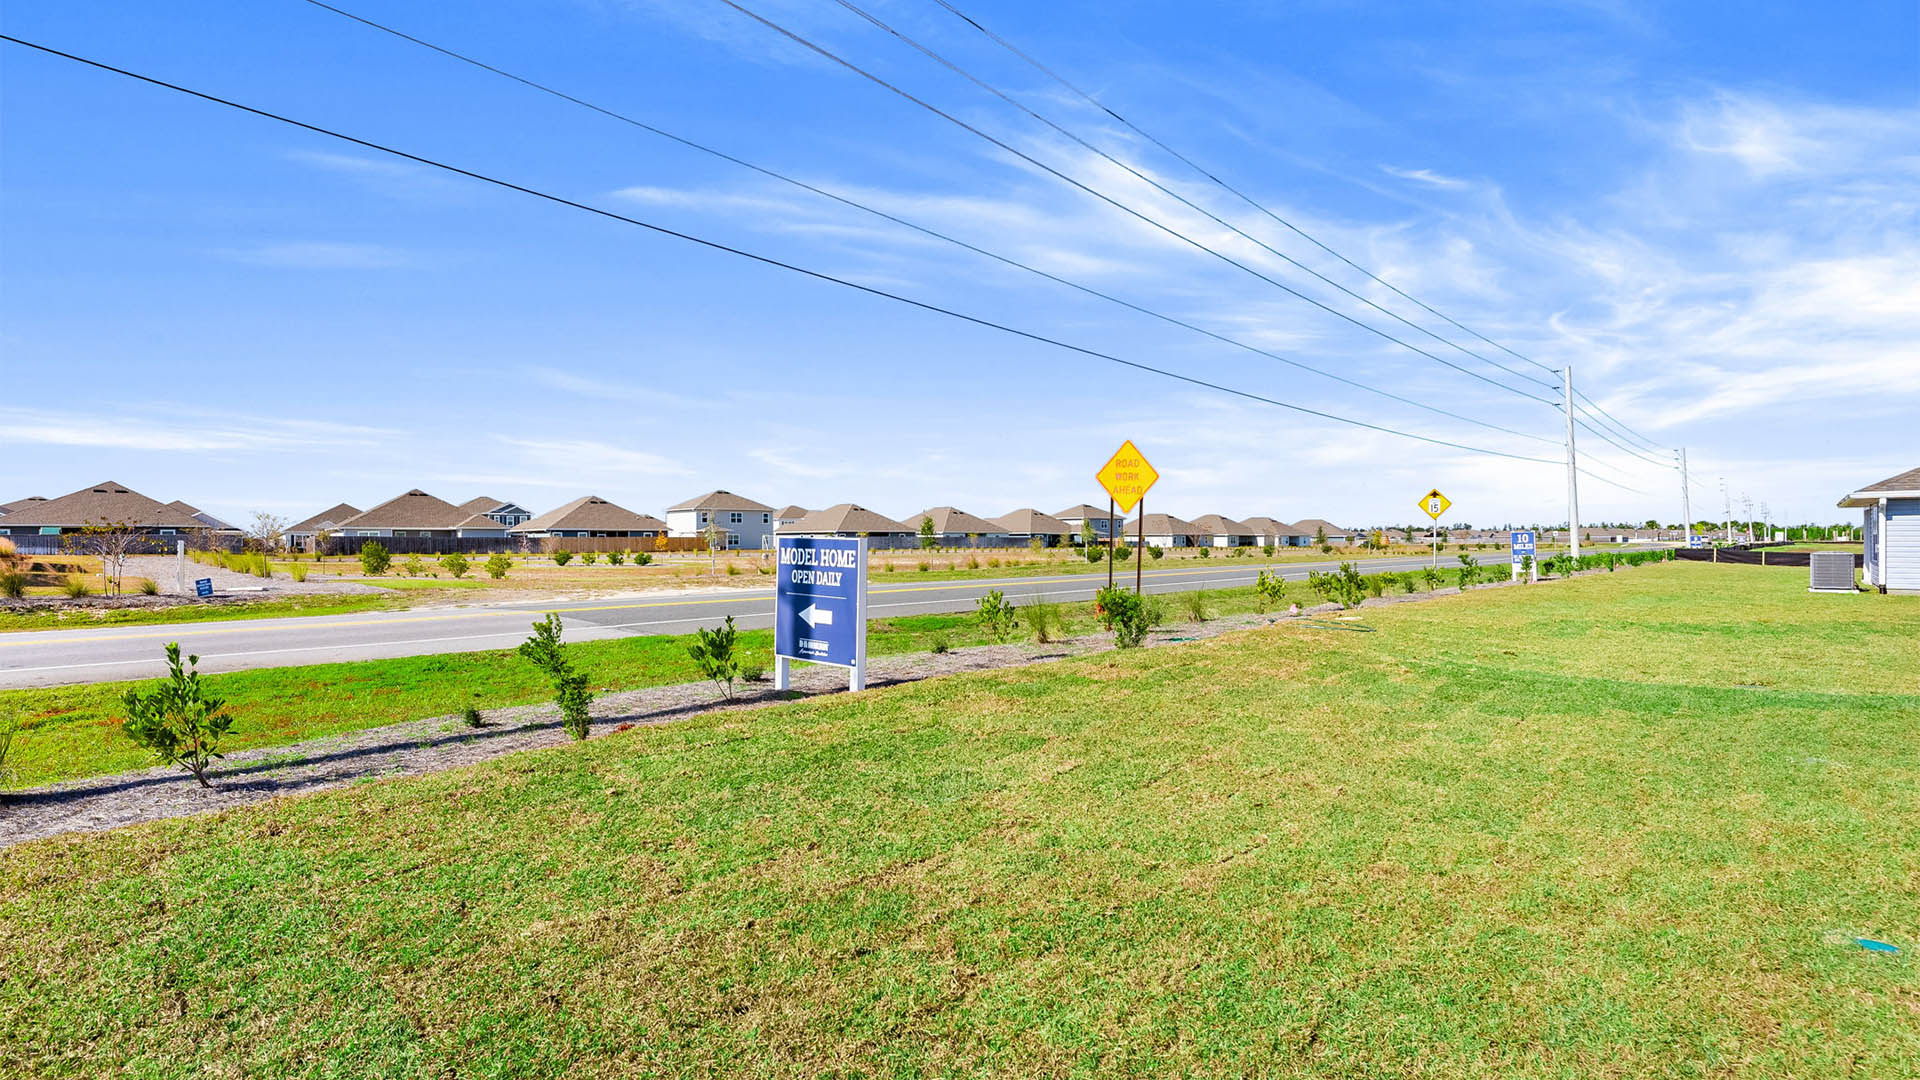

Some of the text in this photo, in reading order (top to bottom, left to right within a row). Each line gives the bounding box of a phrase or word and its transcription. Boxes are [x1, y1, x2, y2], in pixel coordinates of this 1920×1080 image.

[1115, 458, 1140, 468] ROAD
[1115, 472, 1140, 481] WORK
[1112, 485, 1144, 495] AHEAD
[1430, 503, 1439, 513] 15
[1517, 533, 1529, 543] 10
[780, 547, 856, 568] MODEL HOME
[791, 569, 842, 587] OPEN DAILY
